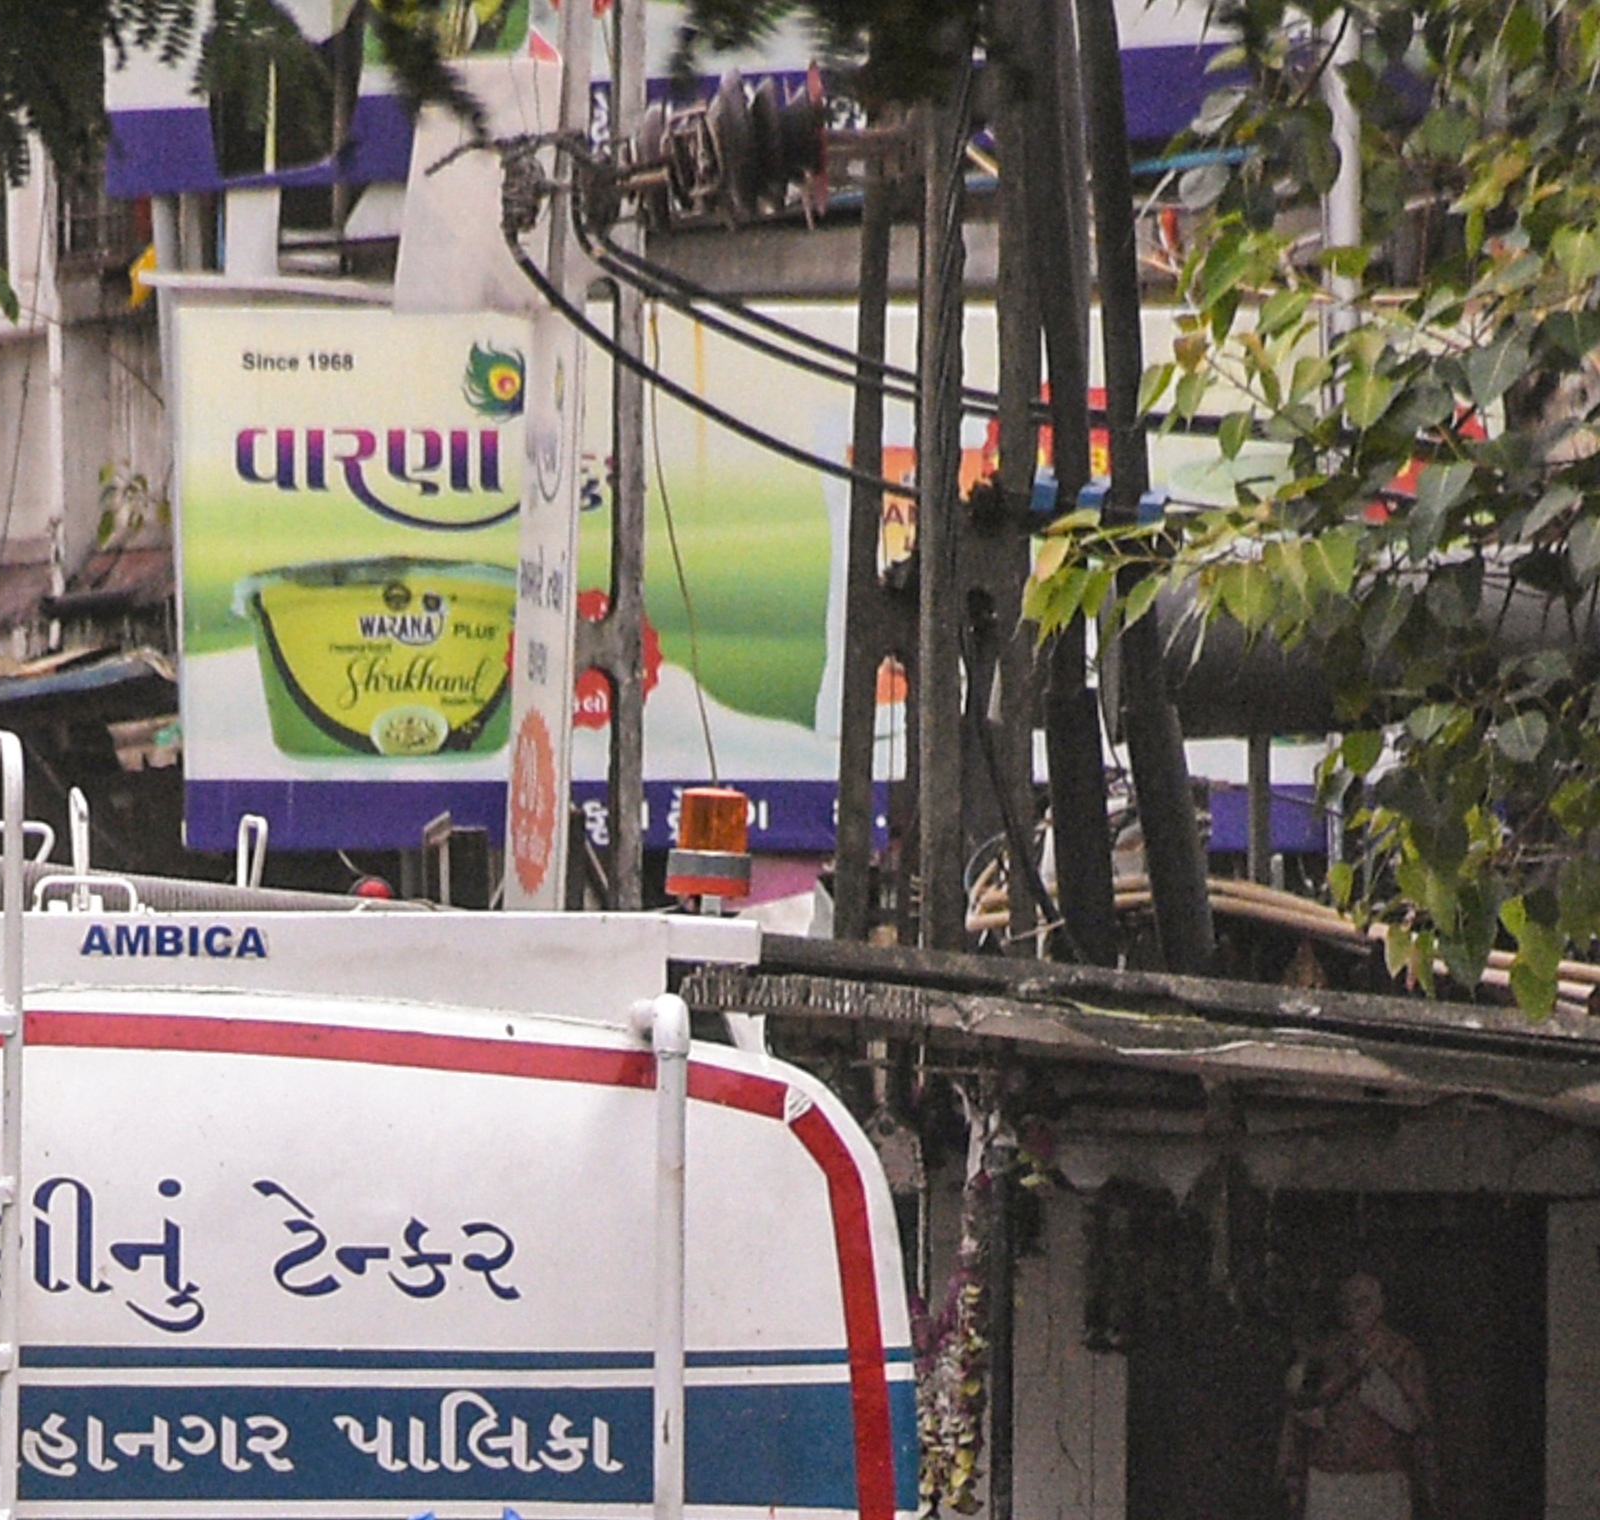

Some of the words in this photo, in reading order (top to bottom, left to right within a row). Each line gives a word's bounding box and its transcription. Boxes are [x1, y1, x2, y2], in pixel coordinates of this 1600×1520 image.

[242, 352, 299, 371] Since
[307, 352, 354, 371] 1968
[359, 615, 439, 643] WARANA
[340, 655, 488, 709] Shrikhand
[79, 924, 267, 958] AMBICA
[252, 1180, 522, 1300] ટેન્કર
[332, 1390, 624, 1473] પાલિકા
